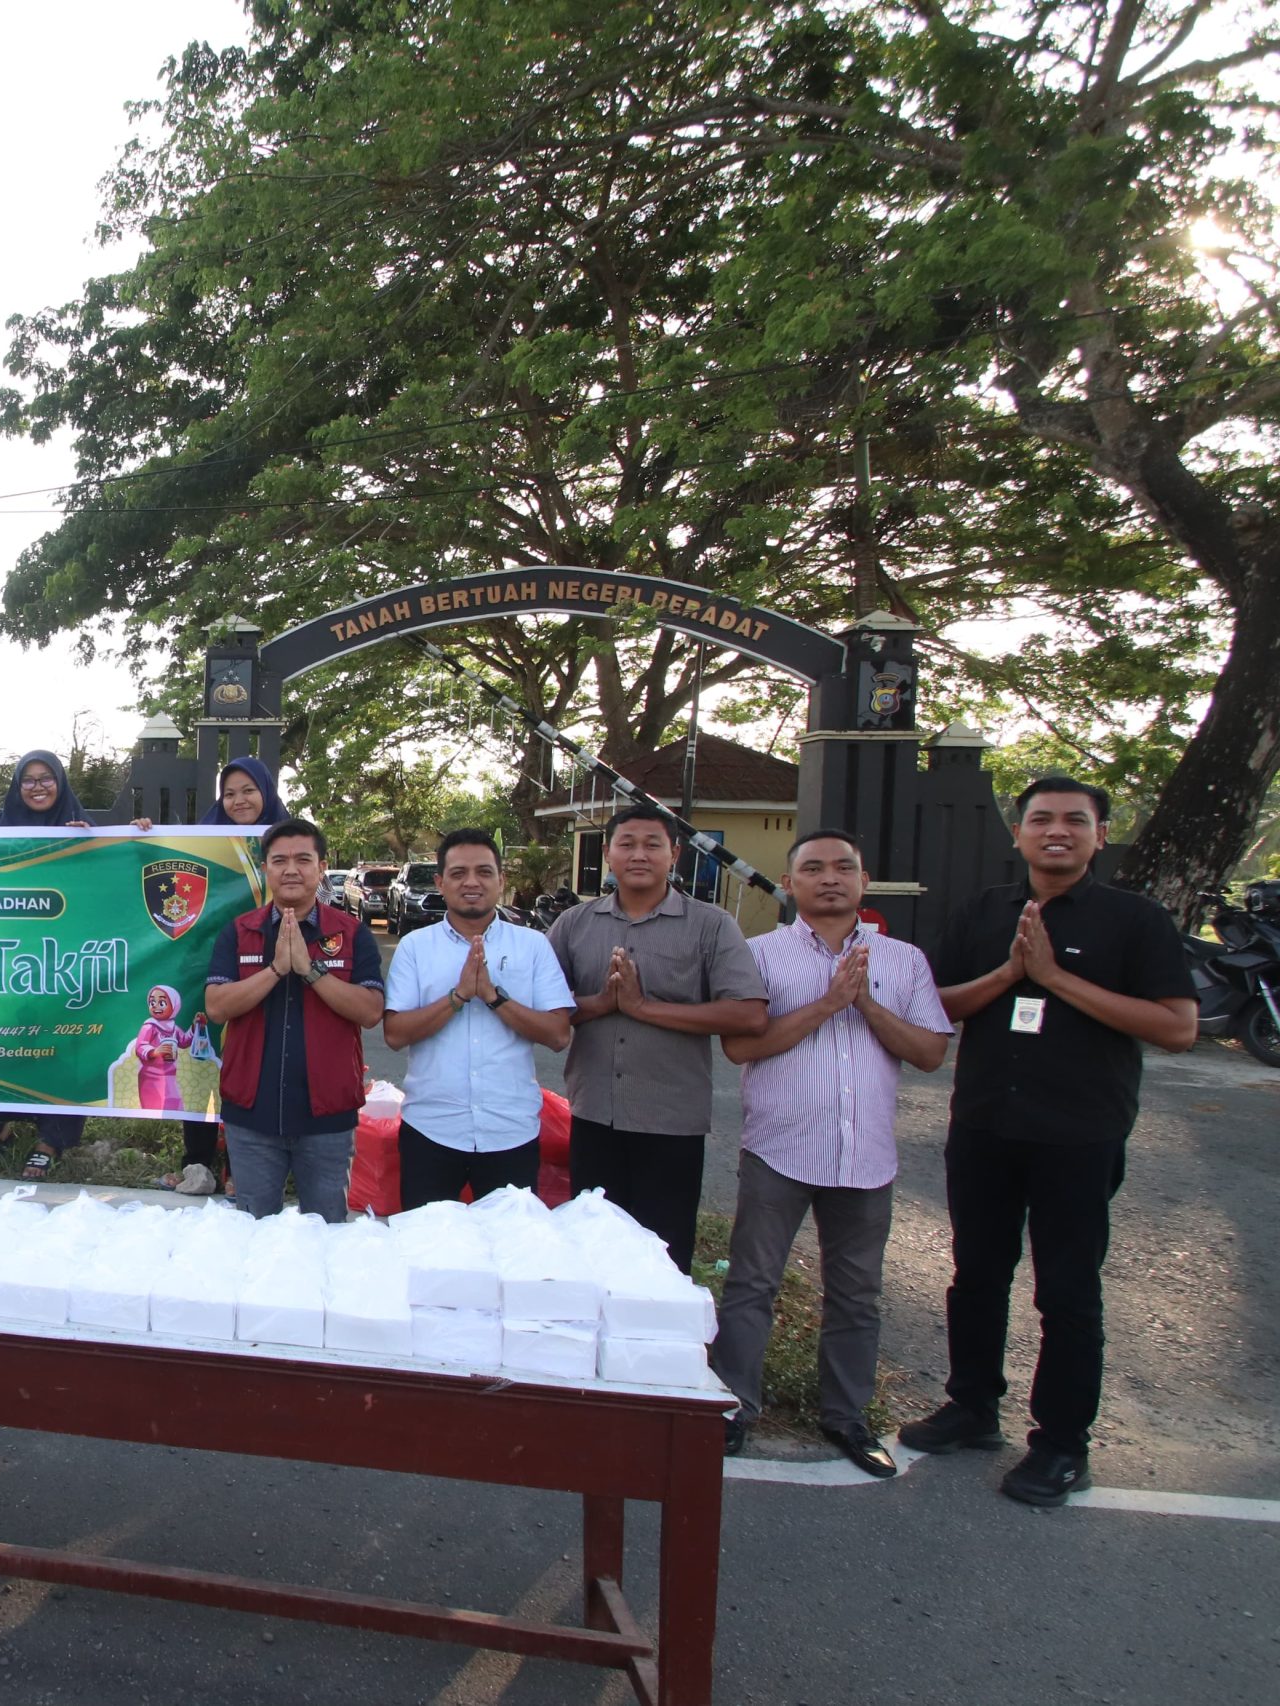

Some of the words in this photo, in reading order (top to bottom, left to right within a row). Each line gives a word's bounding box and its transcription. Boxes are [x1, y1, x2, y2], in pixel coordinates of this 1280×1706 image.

[330, 601, 411, 642] TANAH
[420, 582, 537, 615] BERTUAH
[548, 581, 642, 605] NEGERI
[651, 591, 769, 641] BERADAT
[151, 862, 199, 873] RESERSE
[52, 1023, 84, 1035] 2025
[86, 1023, 104, 1035] M
